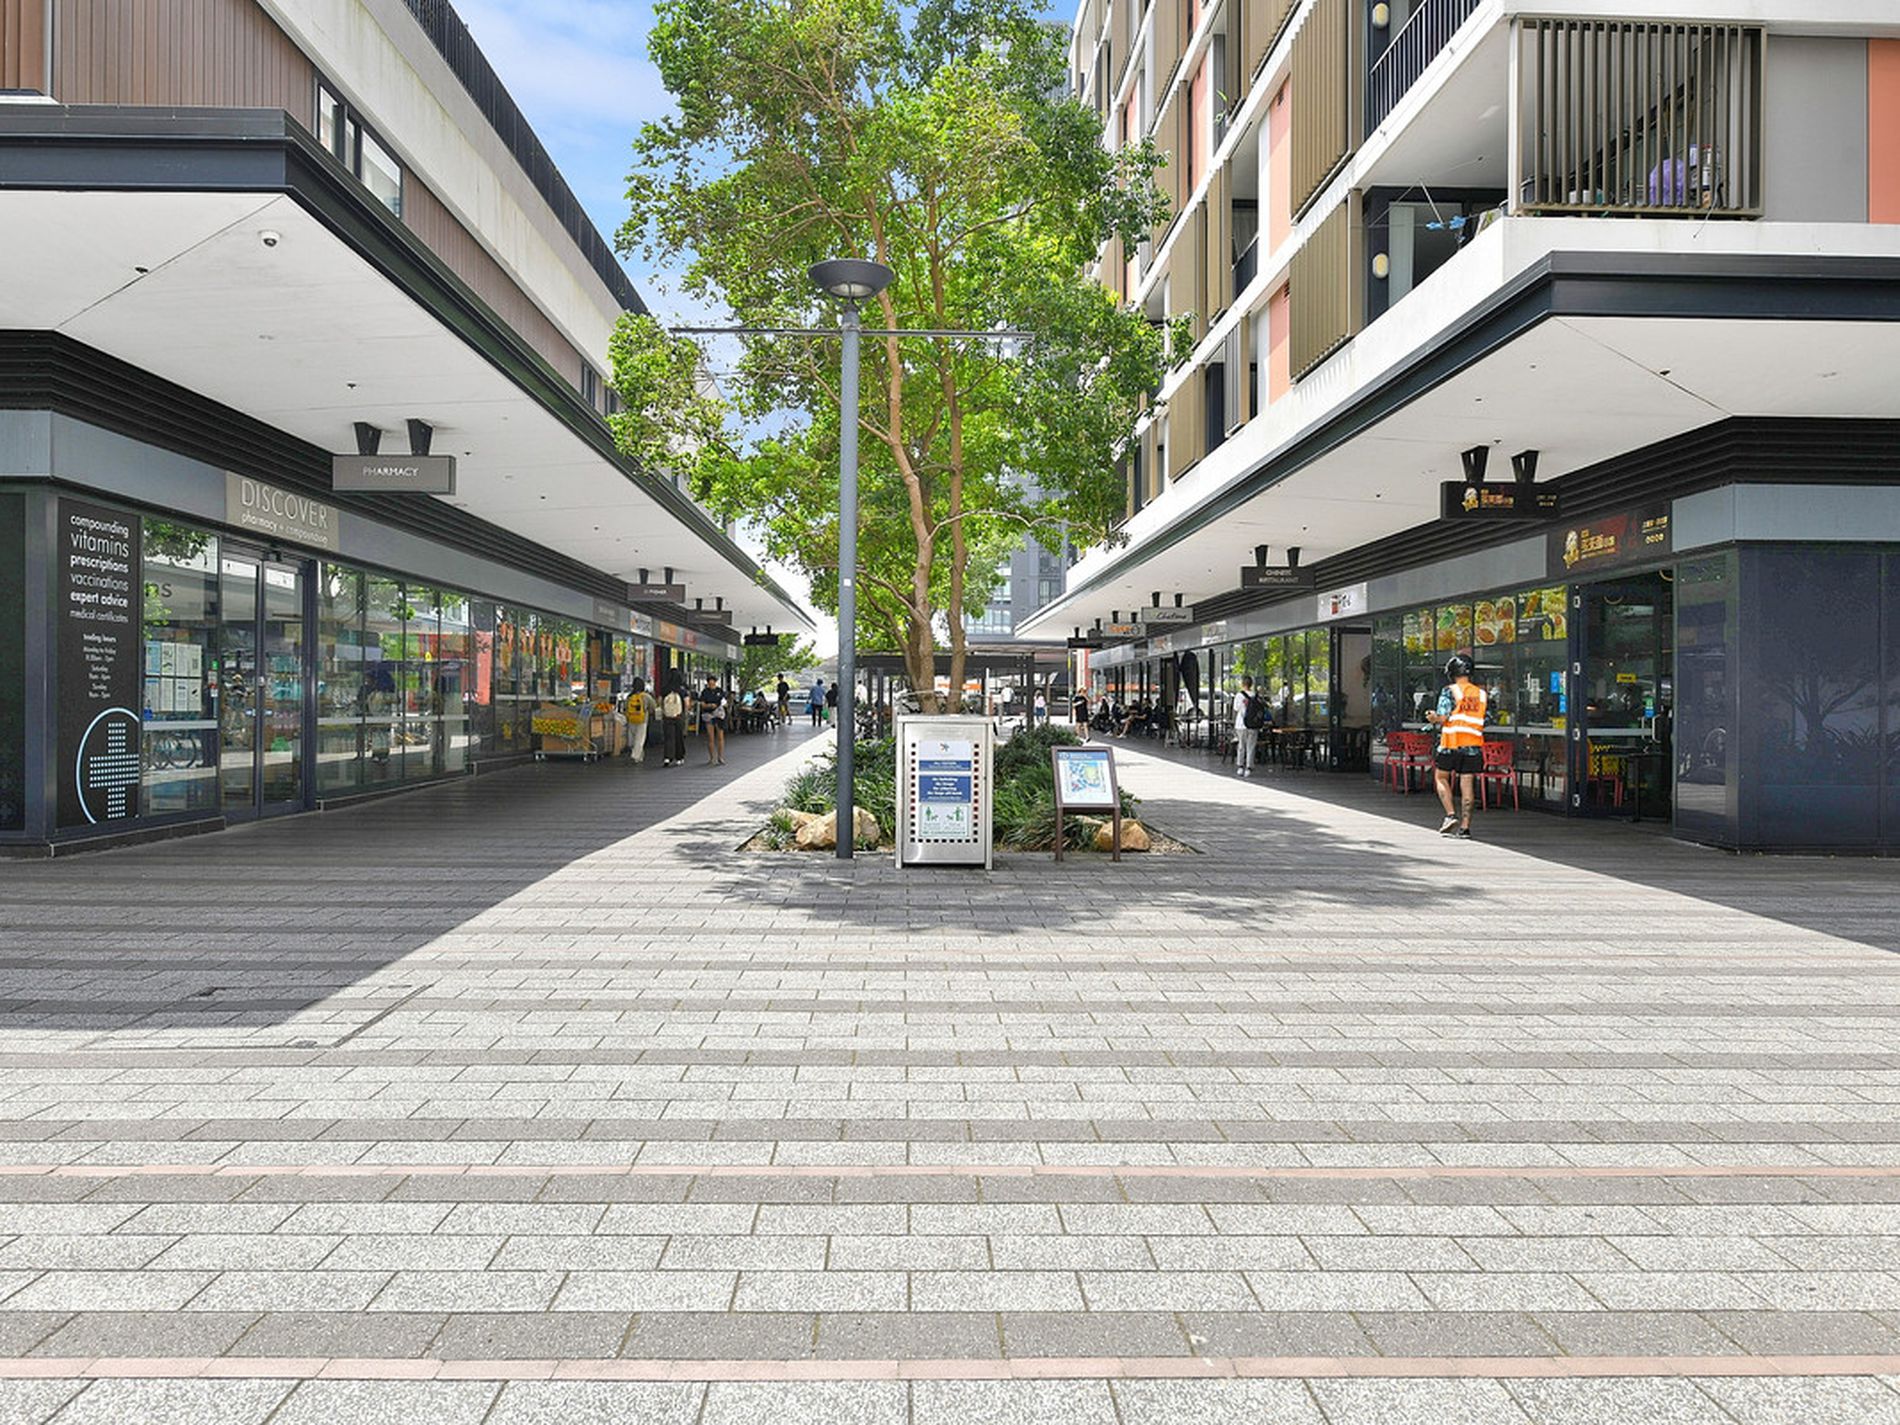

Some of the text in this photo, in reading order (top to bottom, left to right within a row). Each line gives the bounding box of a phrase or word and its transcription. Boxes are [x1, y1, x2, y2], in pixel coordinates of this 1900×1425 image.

[362, 466, 419, 477] PHARMACY
[241, 479, 328, 530] DISCOVER
[70, 515, 129, 539] compounding
[241, 510, 278, 533] pharmacy
[70, 529, 129, 558] vitamins
[70, 555, 129, 574] prescriptions
[70, 573, 129, 592] vaccinations
[70, 591, 128, 608] expert advice
[69, 606, 128, 623] medical certificates
